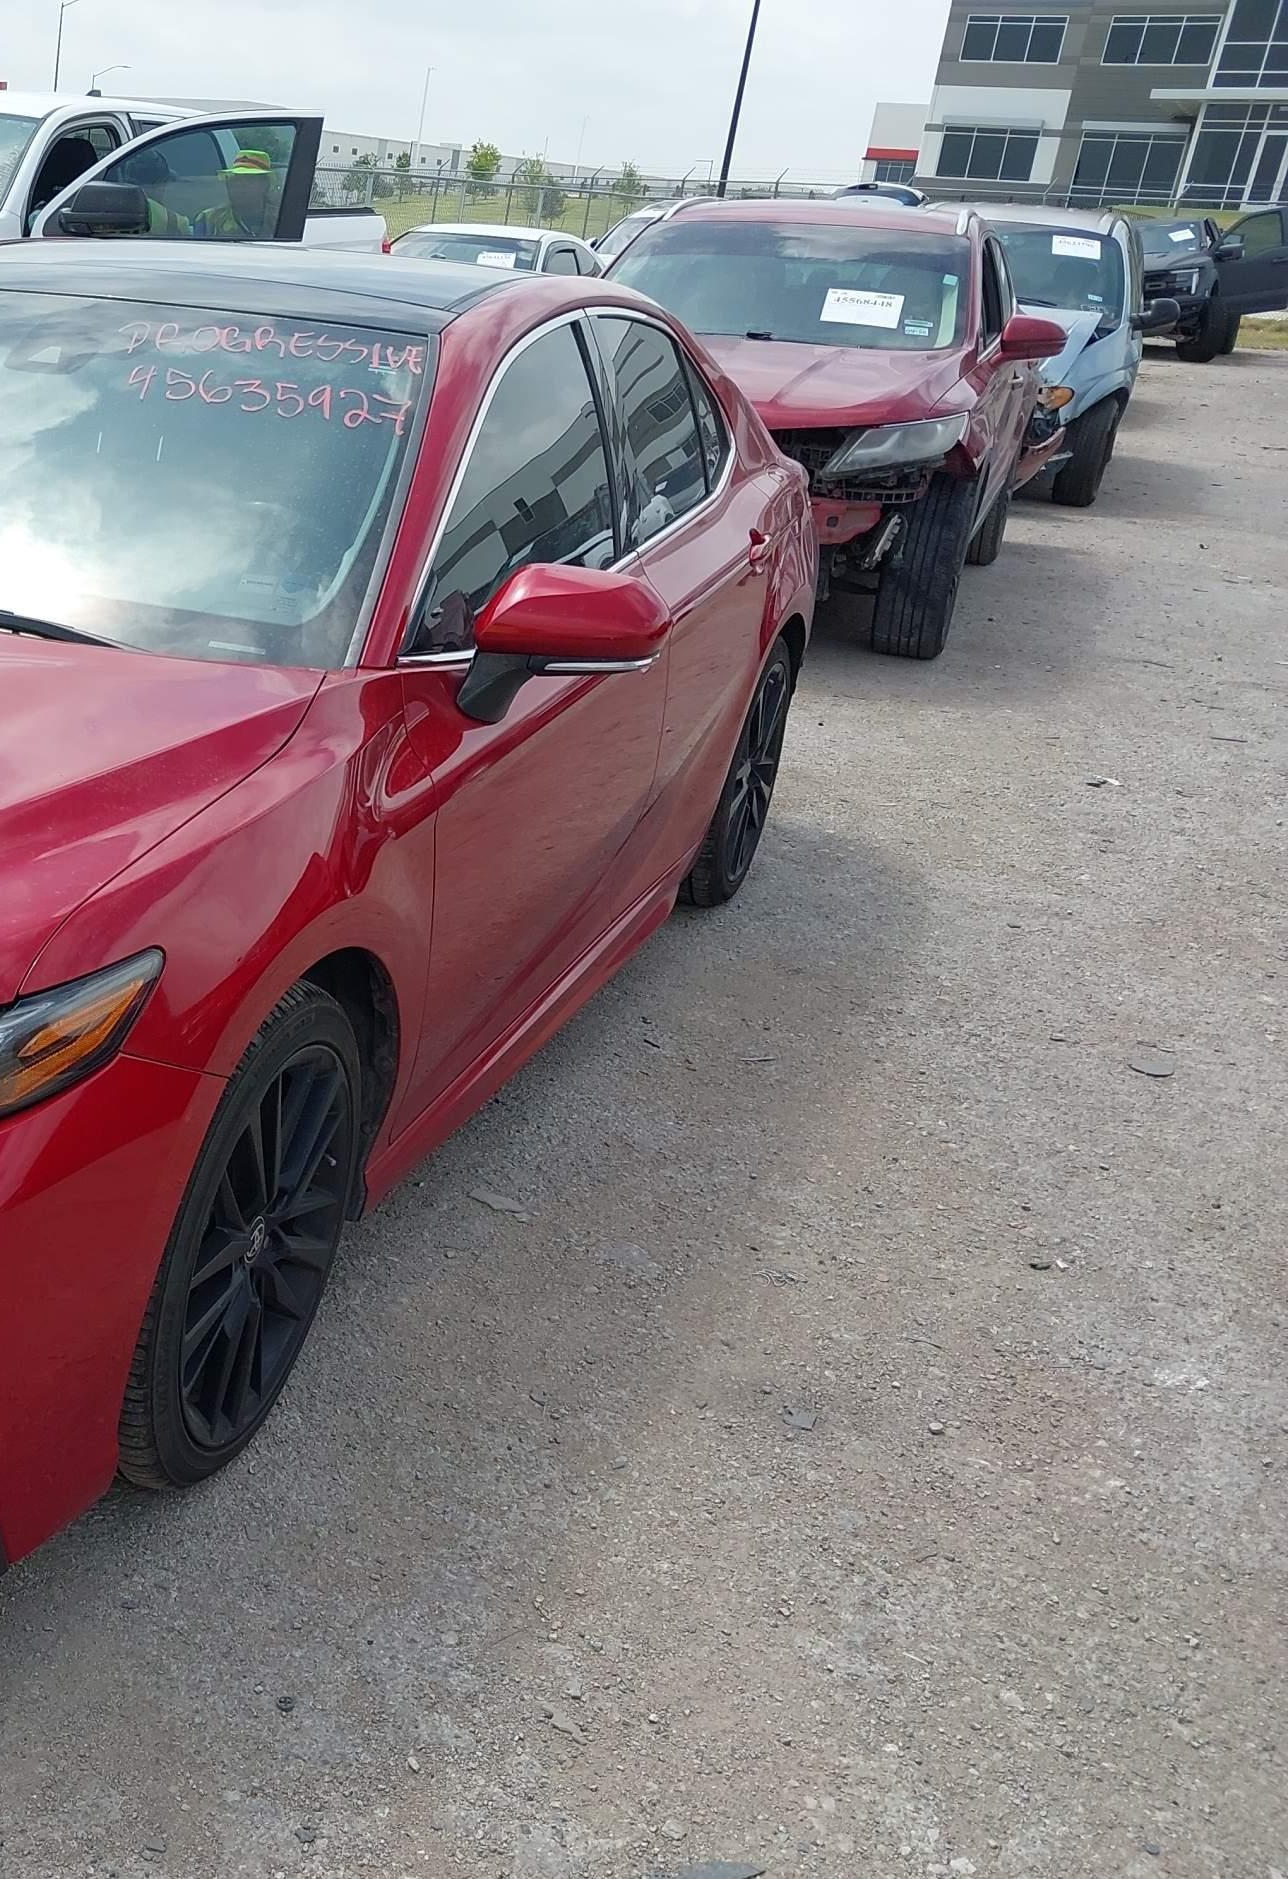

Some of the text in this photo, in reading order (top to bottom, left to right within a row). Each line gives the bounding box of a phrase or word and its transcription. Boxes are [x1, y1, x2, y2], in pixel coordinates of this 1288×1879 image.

[832, 296, 894, 308] 45568448
[118, 321, 424, 374] PROGRESSIVE
[128, 365, 412, 436] 45635927
